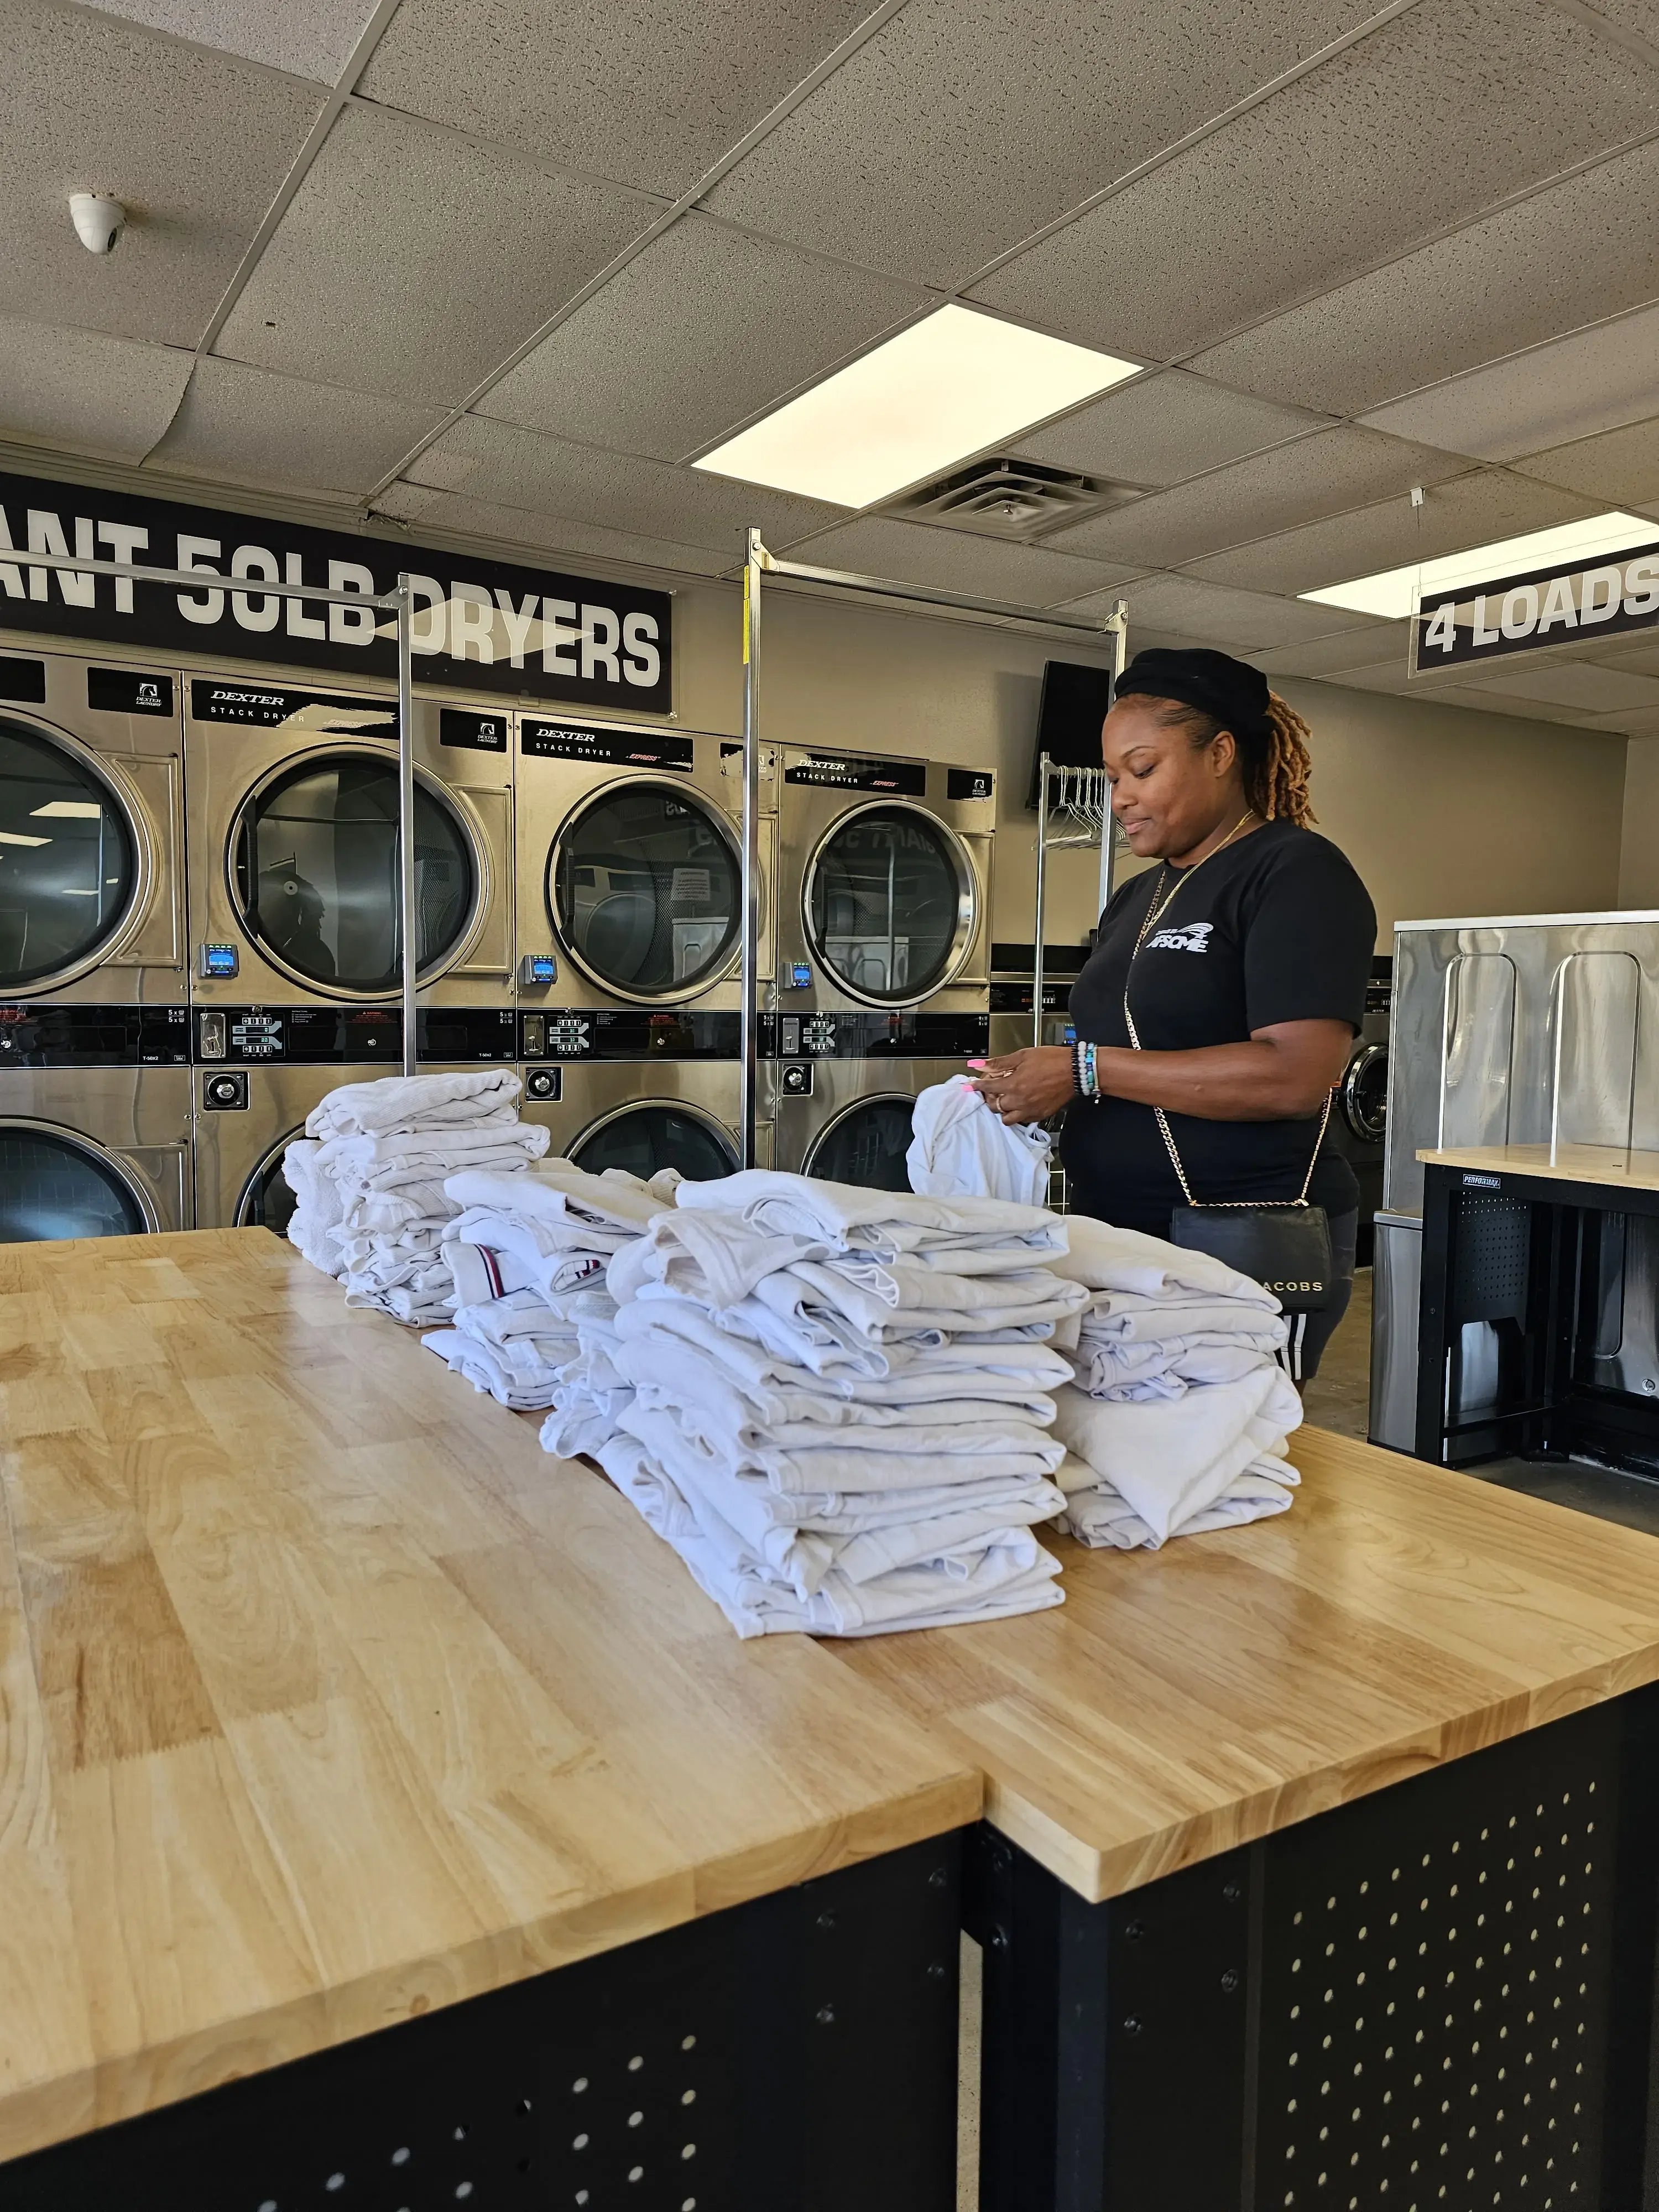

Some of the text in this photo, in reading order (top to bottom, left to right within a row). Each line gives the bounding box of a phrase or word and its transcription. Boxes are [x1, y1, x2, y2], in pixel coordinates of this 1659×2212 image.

[177, 534, 375, 646] 50LB
[399, 572, 660, 687] DRYERS
[1425, 557, 1659, 653] 4 LOADS
[211, 691, 284, 705] DEXTER
[211, 706, 304, 722] STACK DRYER
[536, 728, 595, 742] DEXTER
[536, 743, 611, 757] STACK DRYER
[629, 753, 658, 761] EXPRESS
[797, 759, 846, 771] DEXTER
[796, 772, 858, 784] STACK DRYER
